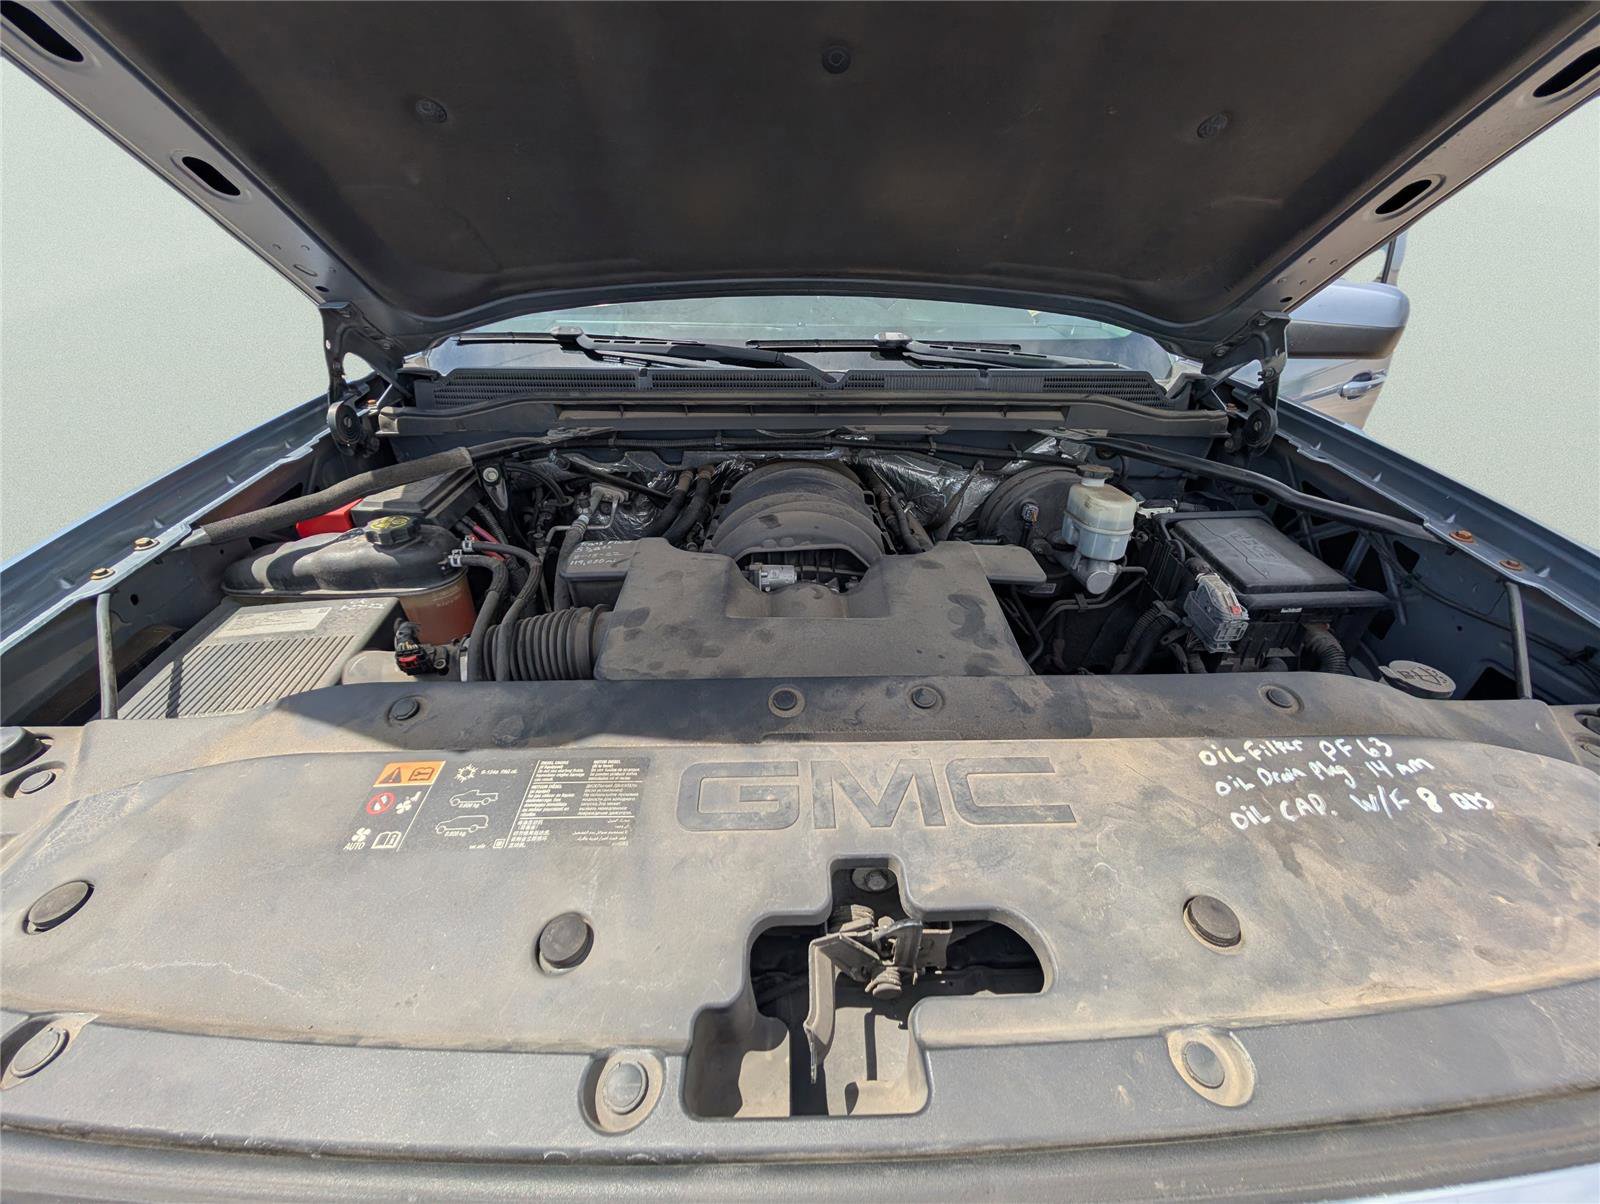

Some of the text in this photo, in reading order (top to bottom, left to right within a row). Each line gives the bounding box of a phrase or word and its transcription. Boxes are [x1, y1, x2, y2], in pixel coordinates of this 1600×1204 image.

[1355, 736, 1393, 758] 63
[1364, 759, 1395, 779] 14
[675, 756, 1077, 832] GMC
[1415, 786, 1443, 813] 8
[343, 841, 366, 850] AUTO
